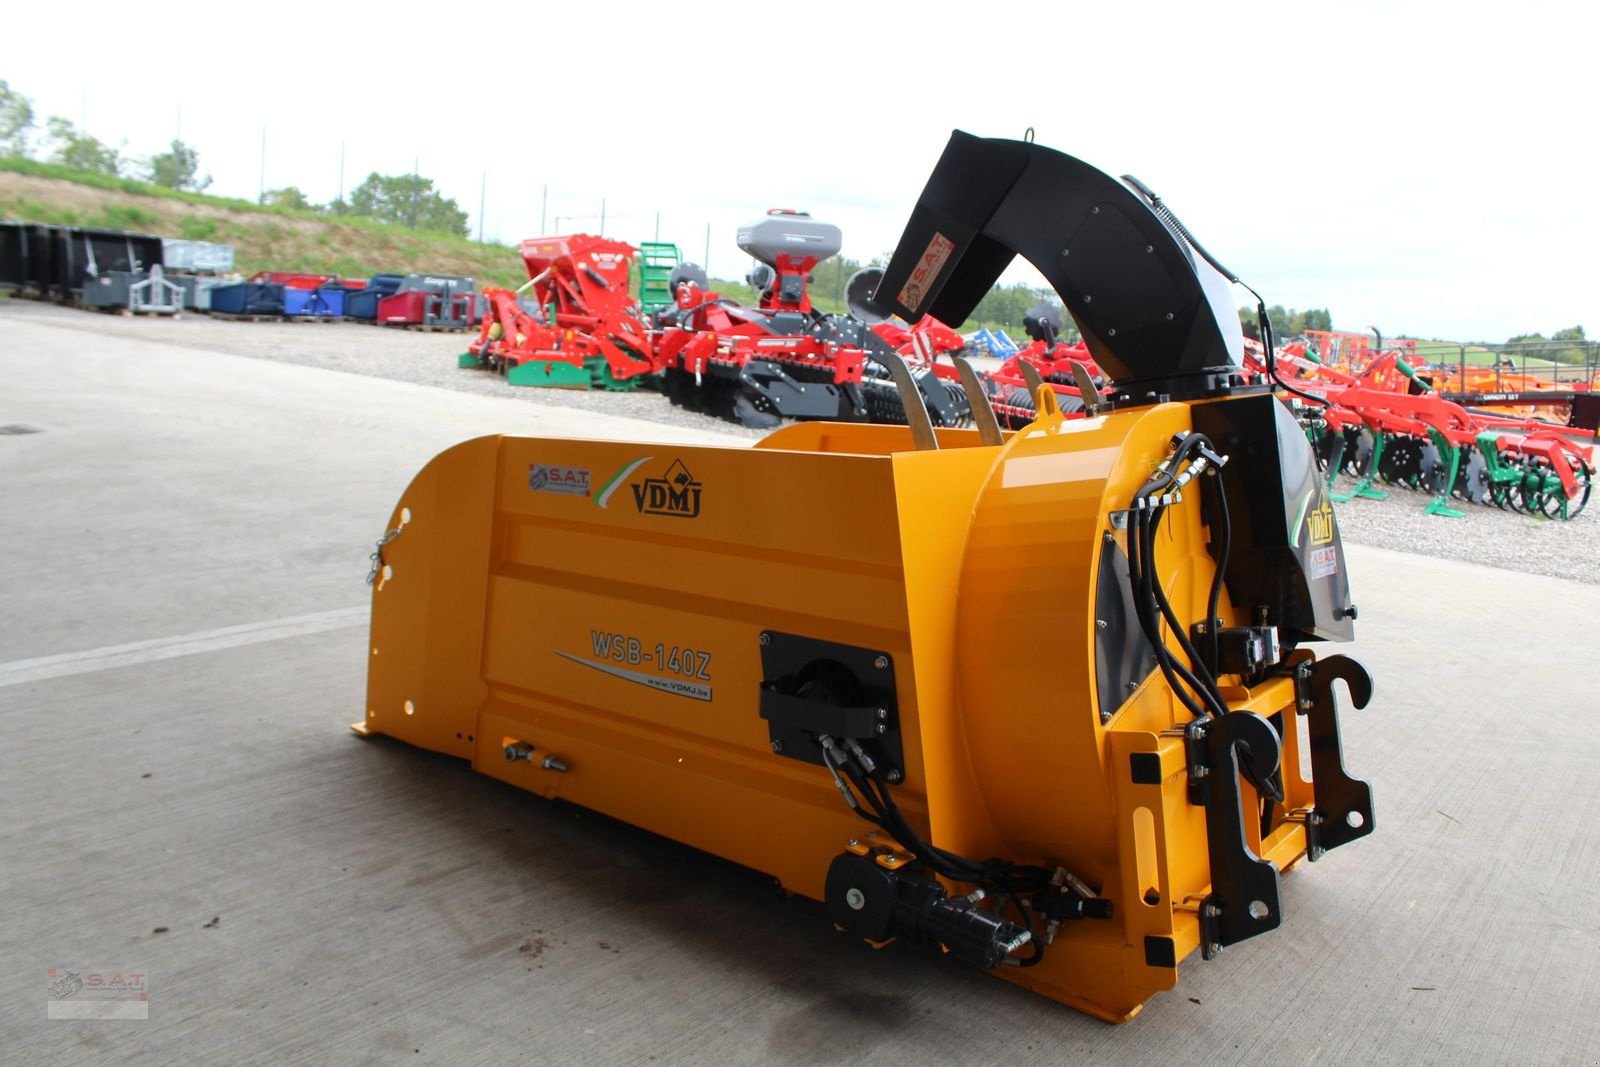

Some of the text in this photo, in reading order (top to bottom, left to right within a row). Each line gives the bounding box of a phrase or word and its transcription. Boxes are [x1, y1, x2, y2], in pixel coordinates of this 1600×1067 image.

[549, 468, 589, 484] S.A.T.
[631, 478, 702, 518] VDMJ
[1307, 508, 1332, 545] VDMJ
[591, 630, 711, 680] WSB-140Z
[648, 679, 708, 696] www.VDMJ.be
